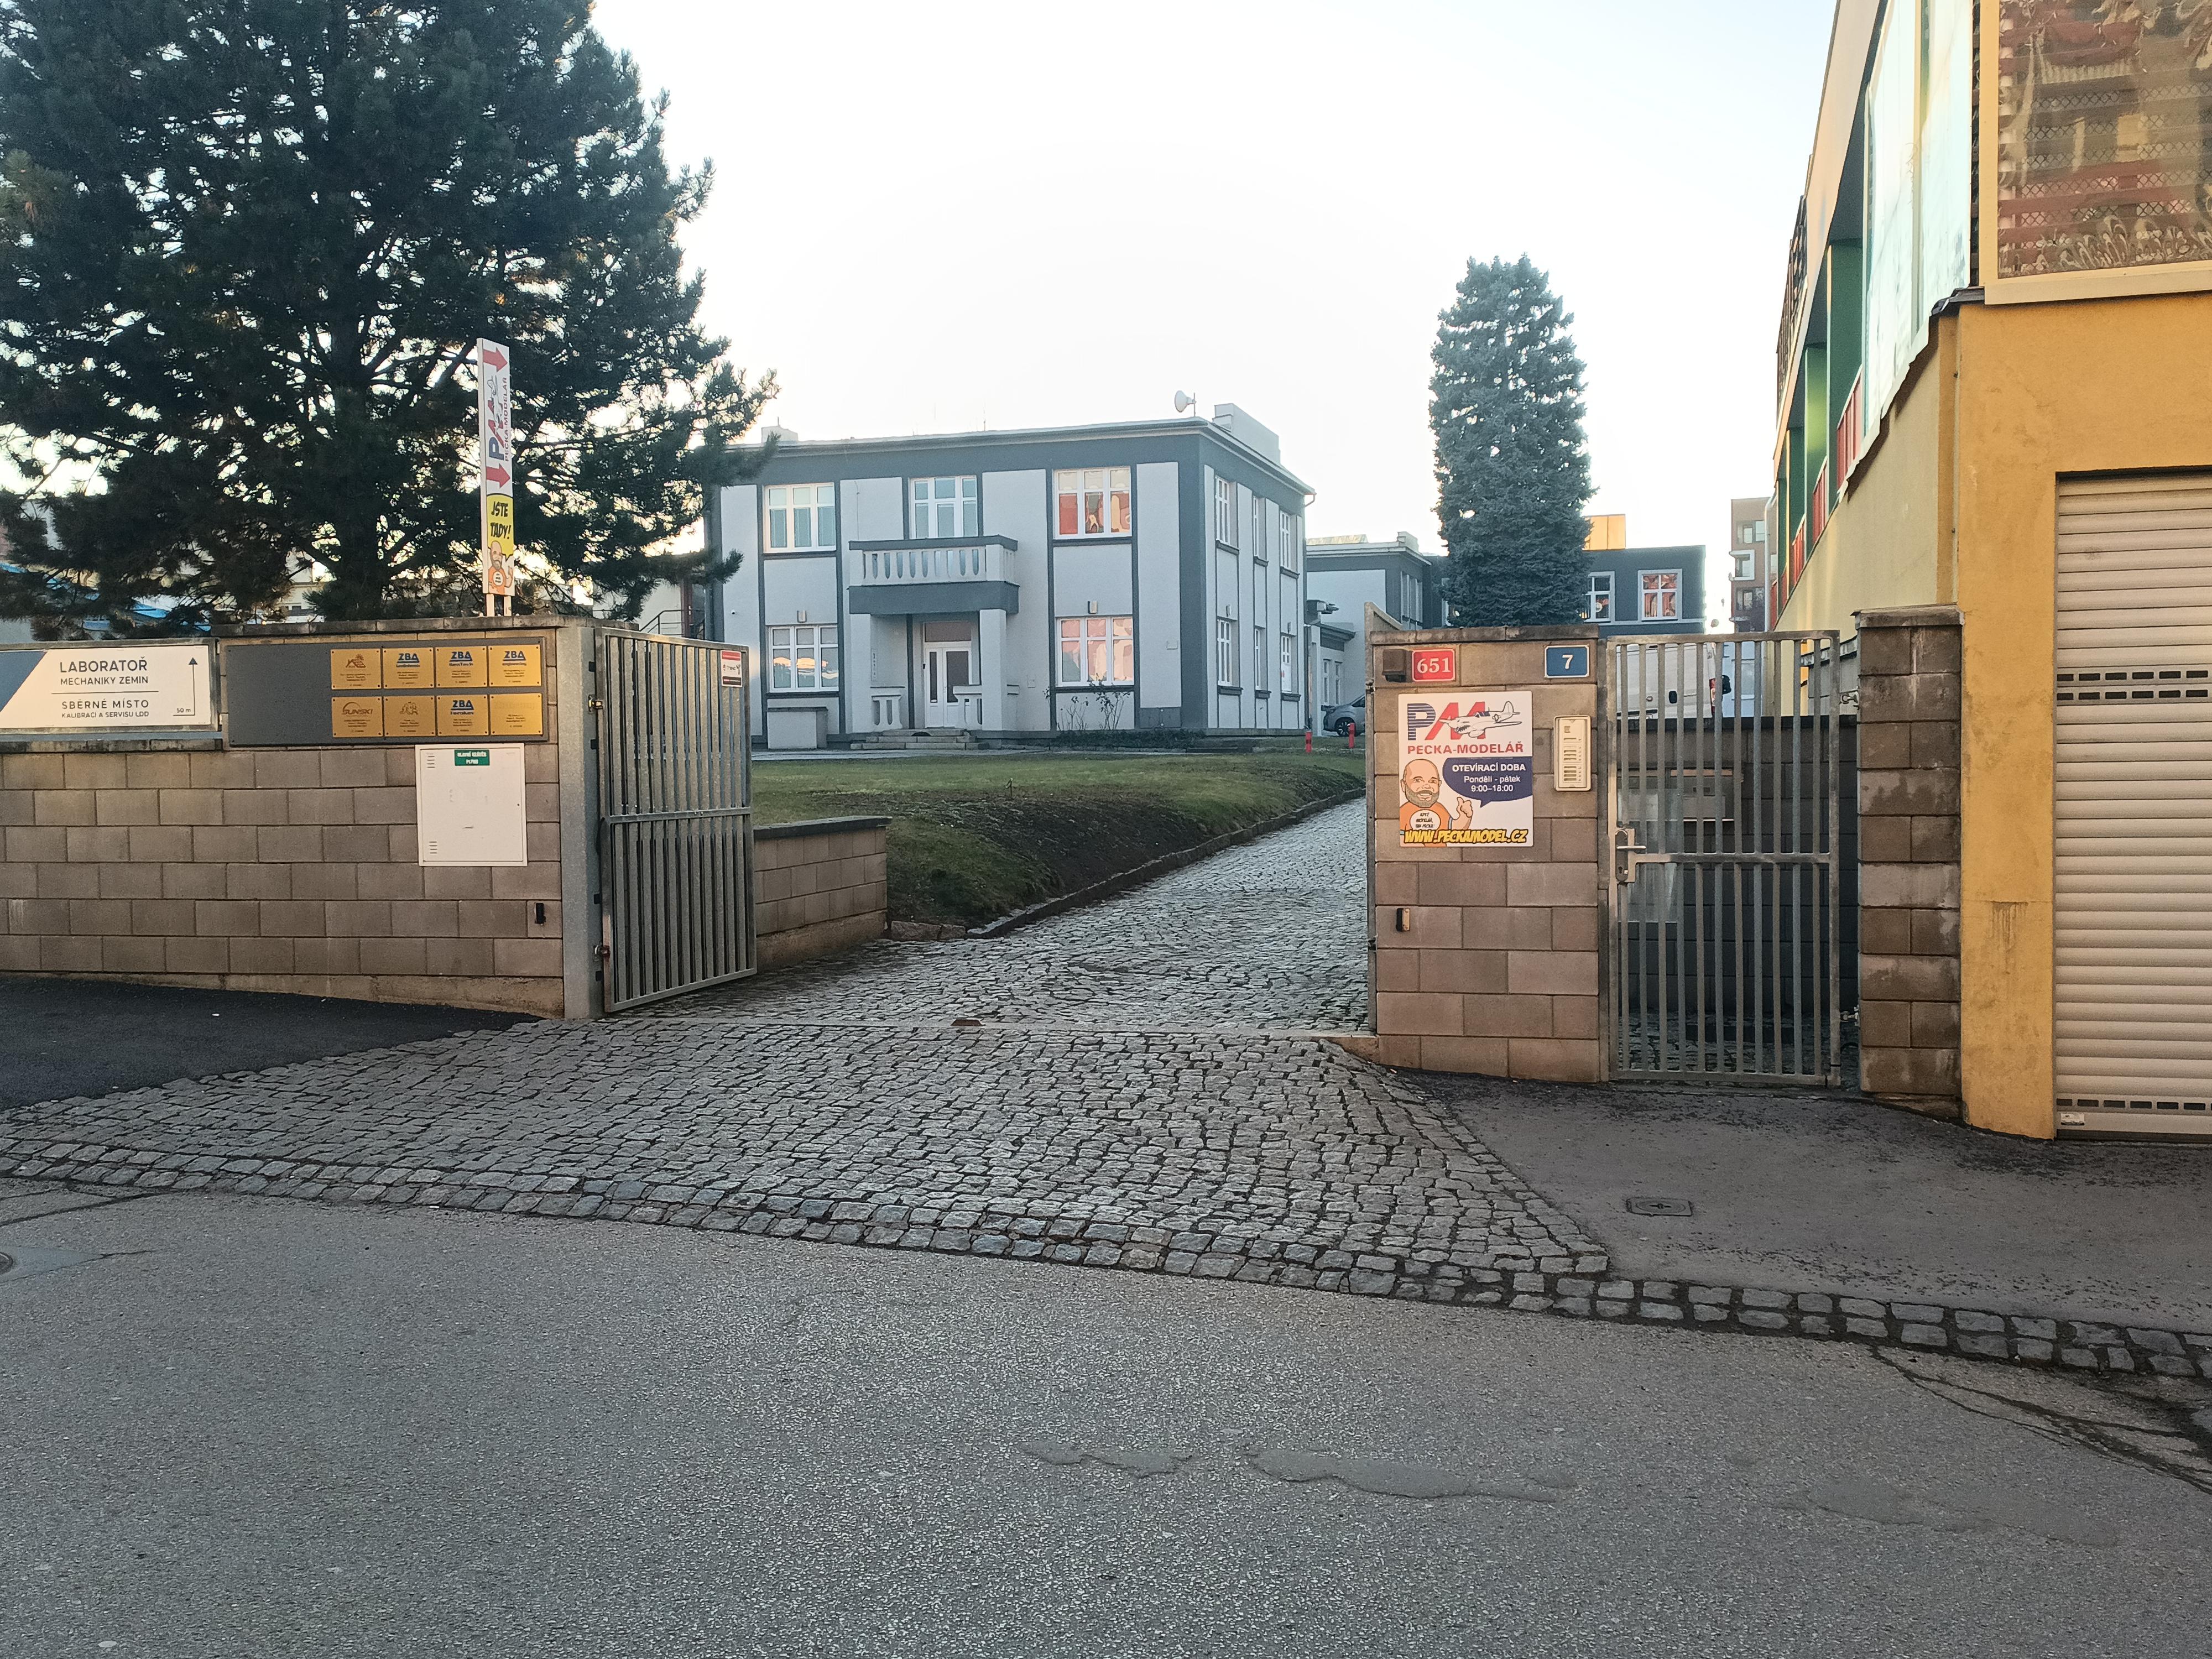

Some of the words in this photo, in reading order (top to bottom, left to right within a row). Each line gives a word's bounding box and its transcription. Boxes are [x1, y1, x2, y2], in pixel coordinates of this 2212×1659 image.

[491, 501, 508, 517] JSTE
[491, 523, 511, 540] TADY!
[398, 653, 419, 662] ZBA
[450, 651, 472, 661] ZBA
[504, 650, 526, 660] ZBA
[60, 656, 147, 672] LABORATOŘ
[1417, 658, 1451, 673] 651
[1562, 655, 1573, 669] 7
[60, 676, 116, 685] MECHANIKY
[119, 676, 148, 684] ZEMIN
[62, 698, 107, 709] SBĚRNÉ
[112, 698, 149, 708] MÍSTO
[452, 700, 474, 709] ZBA
[1407, 741, 1524, 754] PECKA-MODELÁŘ
[1452, 762, 1499, 772] OTEVÍRACÍ
[1499, 775, 1521, 784] pátek
[1404, 829, 1528, 843] WWW.PECKAMODEL.CZ
